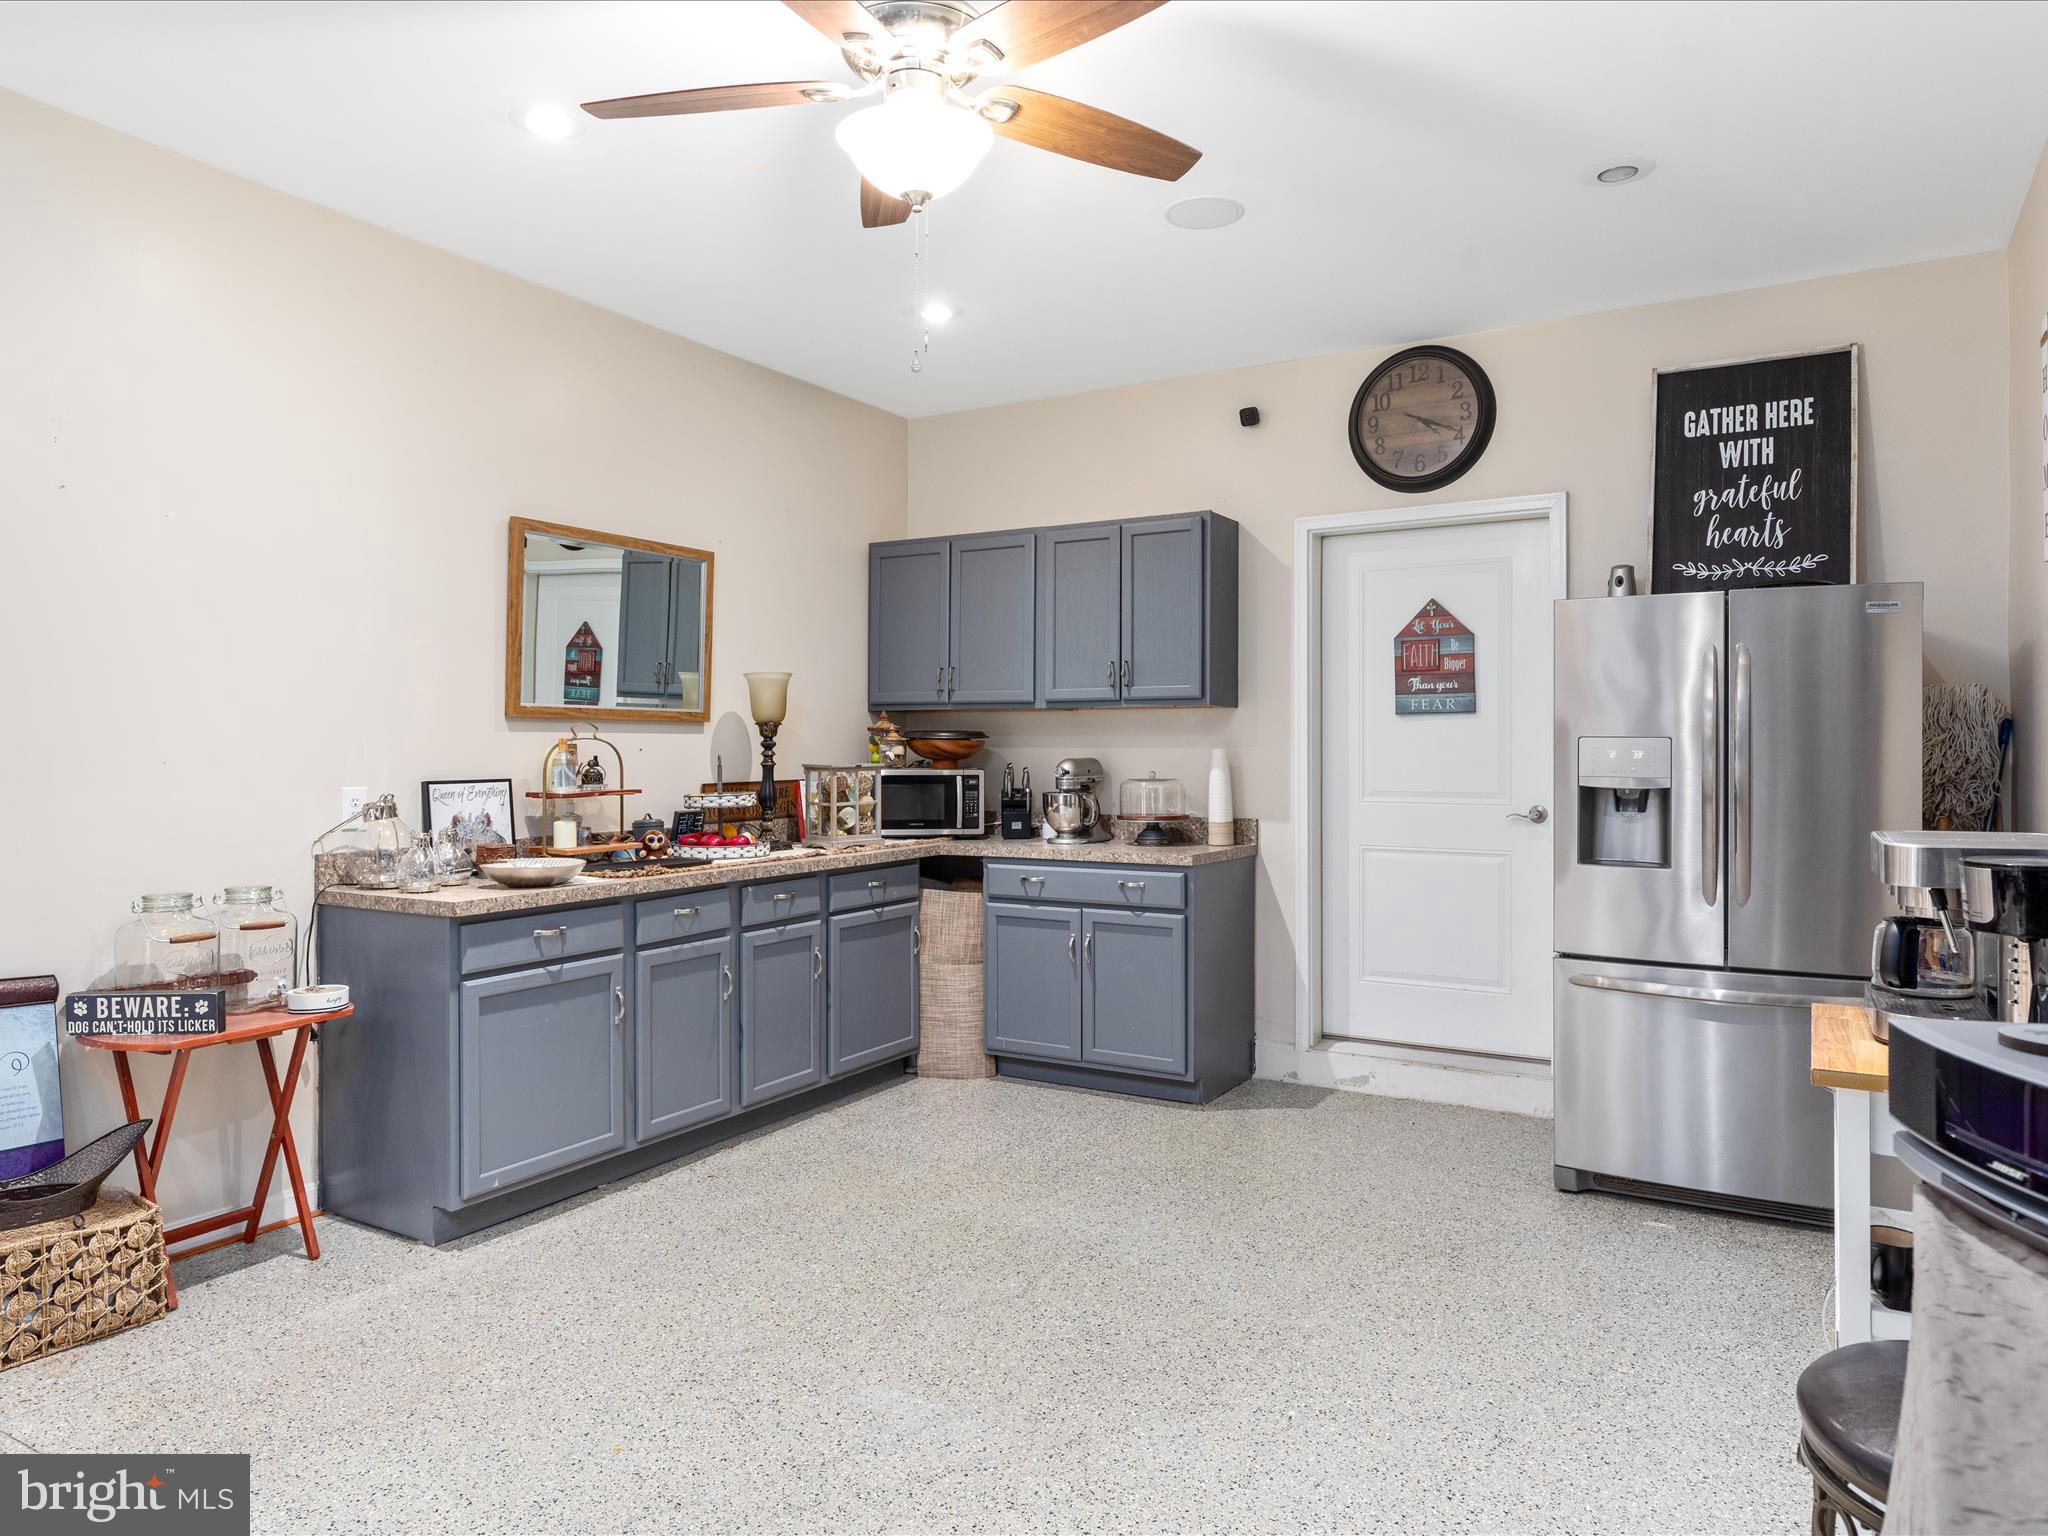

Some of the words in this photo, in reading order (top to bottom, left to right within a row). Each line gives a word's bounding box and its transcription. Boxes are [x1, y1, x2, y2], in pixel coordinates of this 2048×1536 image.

[1385, 373, 1404, 392] 11
[1408, 363, 1430, 383] 12
[1436, 365, 1446, 384] 1
[1451, 380, 1464, 400] 2
[1372, 393, 1391, 412] 10
[1460, 401, 1472, 421] 3
[1367, 415, 1379, 435] 9
[1684, 403, 1758, 438] GATHER
[1765, 397, 1815, 430] HERE
[1454, 426, 1465, 444] 4
[1375, 437, 1385, 455] 8
[1438, 445, 1448, 463] 5
[1718, 436, 1775, 469] WITH
[1392, 450, 1405, 469] 7
[1414, 454, 1426, 472] 6
[1693, 467, 1803, 517] grateful
[1706, 511, 1792, 550] hearts
[1430, 619, 1455, 633] Your
[1450, 638, 1460, 652] Be
[1403, 641, 1439, 671] FAITH
[1444, 656, 1466, 672] Bigger
[1408, 676, 1434, 691] Than
[1436, 680, 1459, 692] your
[1411, 698, 1455, 710] FEAR
[433, 788, 455, 806] Queen
[457, 788, 465, 803] of
[467, 786, 507, 806] Everything
[96, 996, 190, 1019] BEWARE:
[68, 1020, 90, 1034] DOG
[127, 1020, 156, 1034] HOLD
[157, 1019, 175, 1033] ITS
[178, 1019, 216, 1032] LICKER
